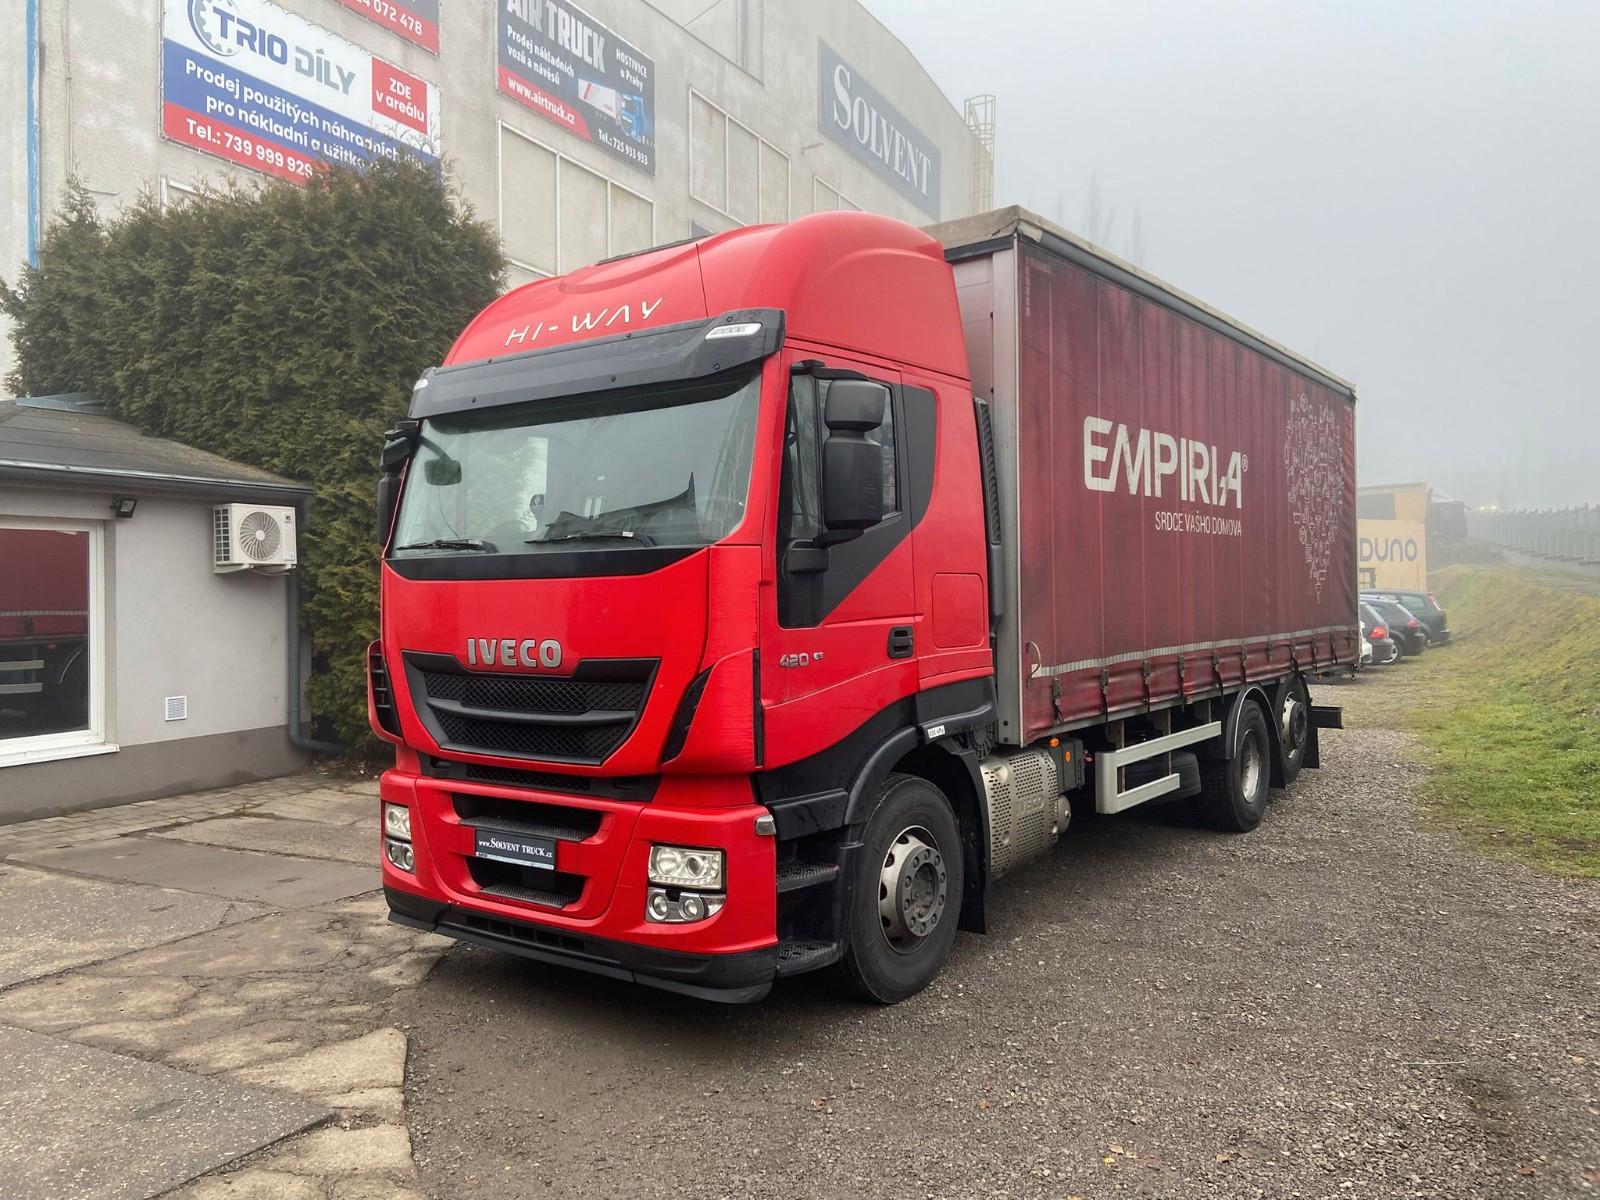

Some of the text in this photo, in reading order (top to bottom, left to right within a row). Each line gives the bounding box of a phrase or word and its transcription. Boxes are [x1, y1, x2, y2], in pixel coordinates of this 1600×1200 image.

[373, 0, 422, 35] 072 478
[213, 6, 356, 95] TRIO DÍLY
[507, 24, 574, 78] Prodej nákladních
[545, 0, 606, 73] TRUCK
[527, 57, 532, 68] a
[616, 48, 647, 78] HOSTIVICE
[185, 58, 240, 99] Prodej
[243, 86, 319, 128] použitých
[389, 77, 412, 100] ZDE
[625, 69, 643, 92] Prahy
[375, 90, 425, 122] v areálu
[508, 76, 575, 125] www.airtruck.cz
[206, 95, 235, 117] pro
[238, 108, 308, 147] nákladní
[311, 138, 320, 151] a
[833, 64, 931, 195] SOLVENT
[186, 118, 221, 144] Tel.:
[224, 131, 252, 155] 739
[255, 144, 284, 167] 999
[1155, 510, 1242, 537] SRDCE VAŠHO DOMOVA
[467, 638, 562, 668] IVECO
[779, 653, 809, 668] 420
